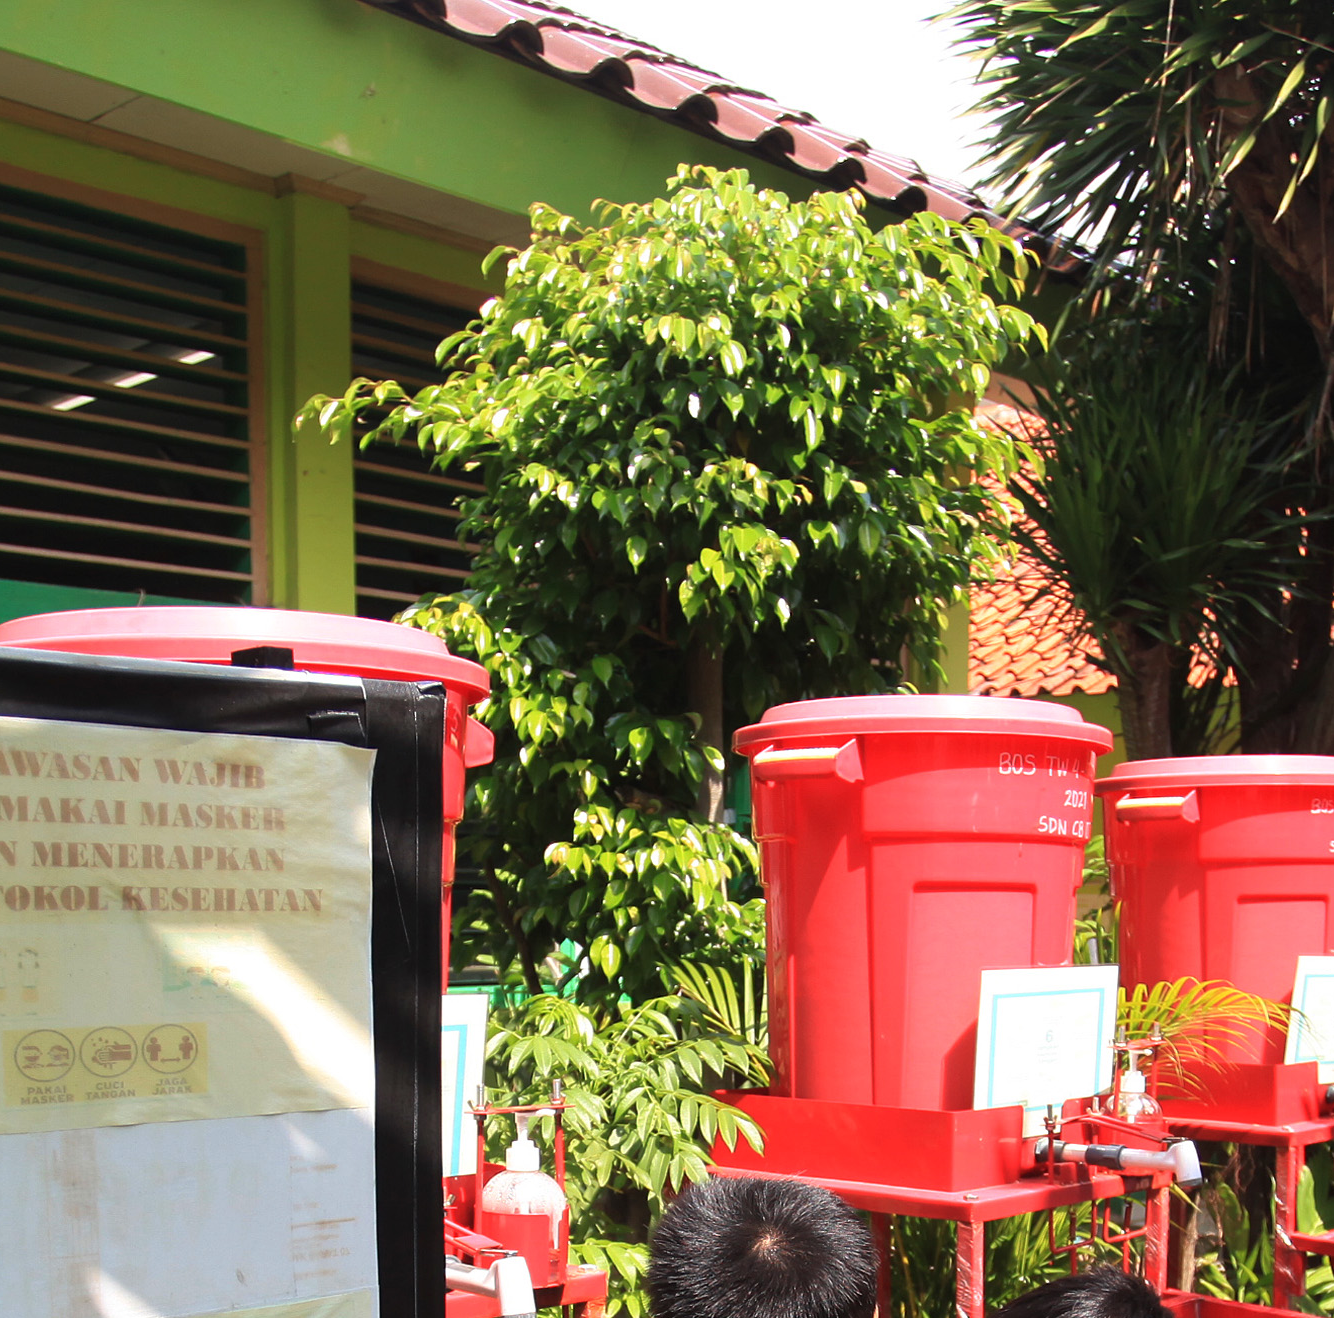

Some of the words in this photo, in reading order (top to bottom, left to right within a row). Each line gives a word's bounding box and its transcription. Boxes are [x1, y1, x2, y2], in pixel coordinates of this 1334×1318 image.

[155, 757, 266, 790] WAJIB
[999, 752, 1037, 775] BOS
[1063, 789, 1088, 810] 2021
[140, 801, 286, 831] MASKER
[1037, 815, 1068, 835] SDN
[31, 841, 286, 871] MENERAPKAN
[122, 886, 323, 913] KESEHATAN
[27, 1085, 67, 1096] PAKAI
[95, 1081, 125, 1091] CUCI
[152, 1085, 193, 1095] JARAK
[155, 1077, 188, 1087] JAGA
[20, 1095, 75, 1105] MASKER
[85, 1090, 136, 1101] TANGAN
